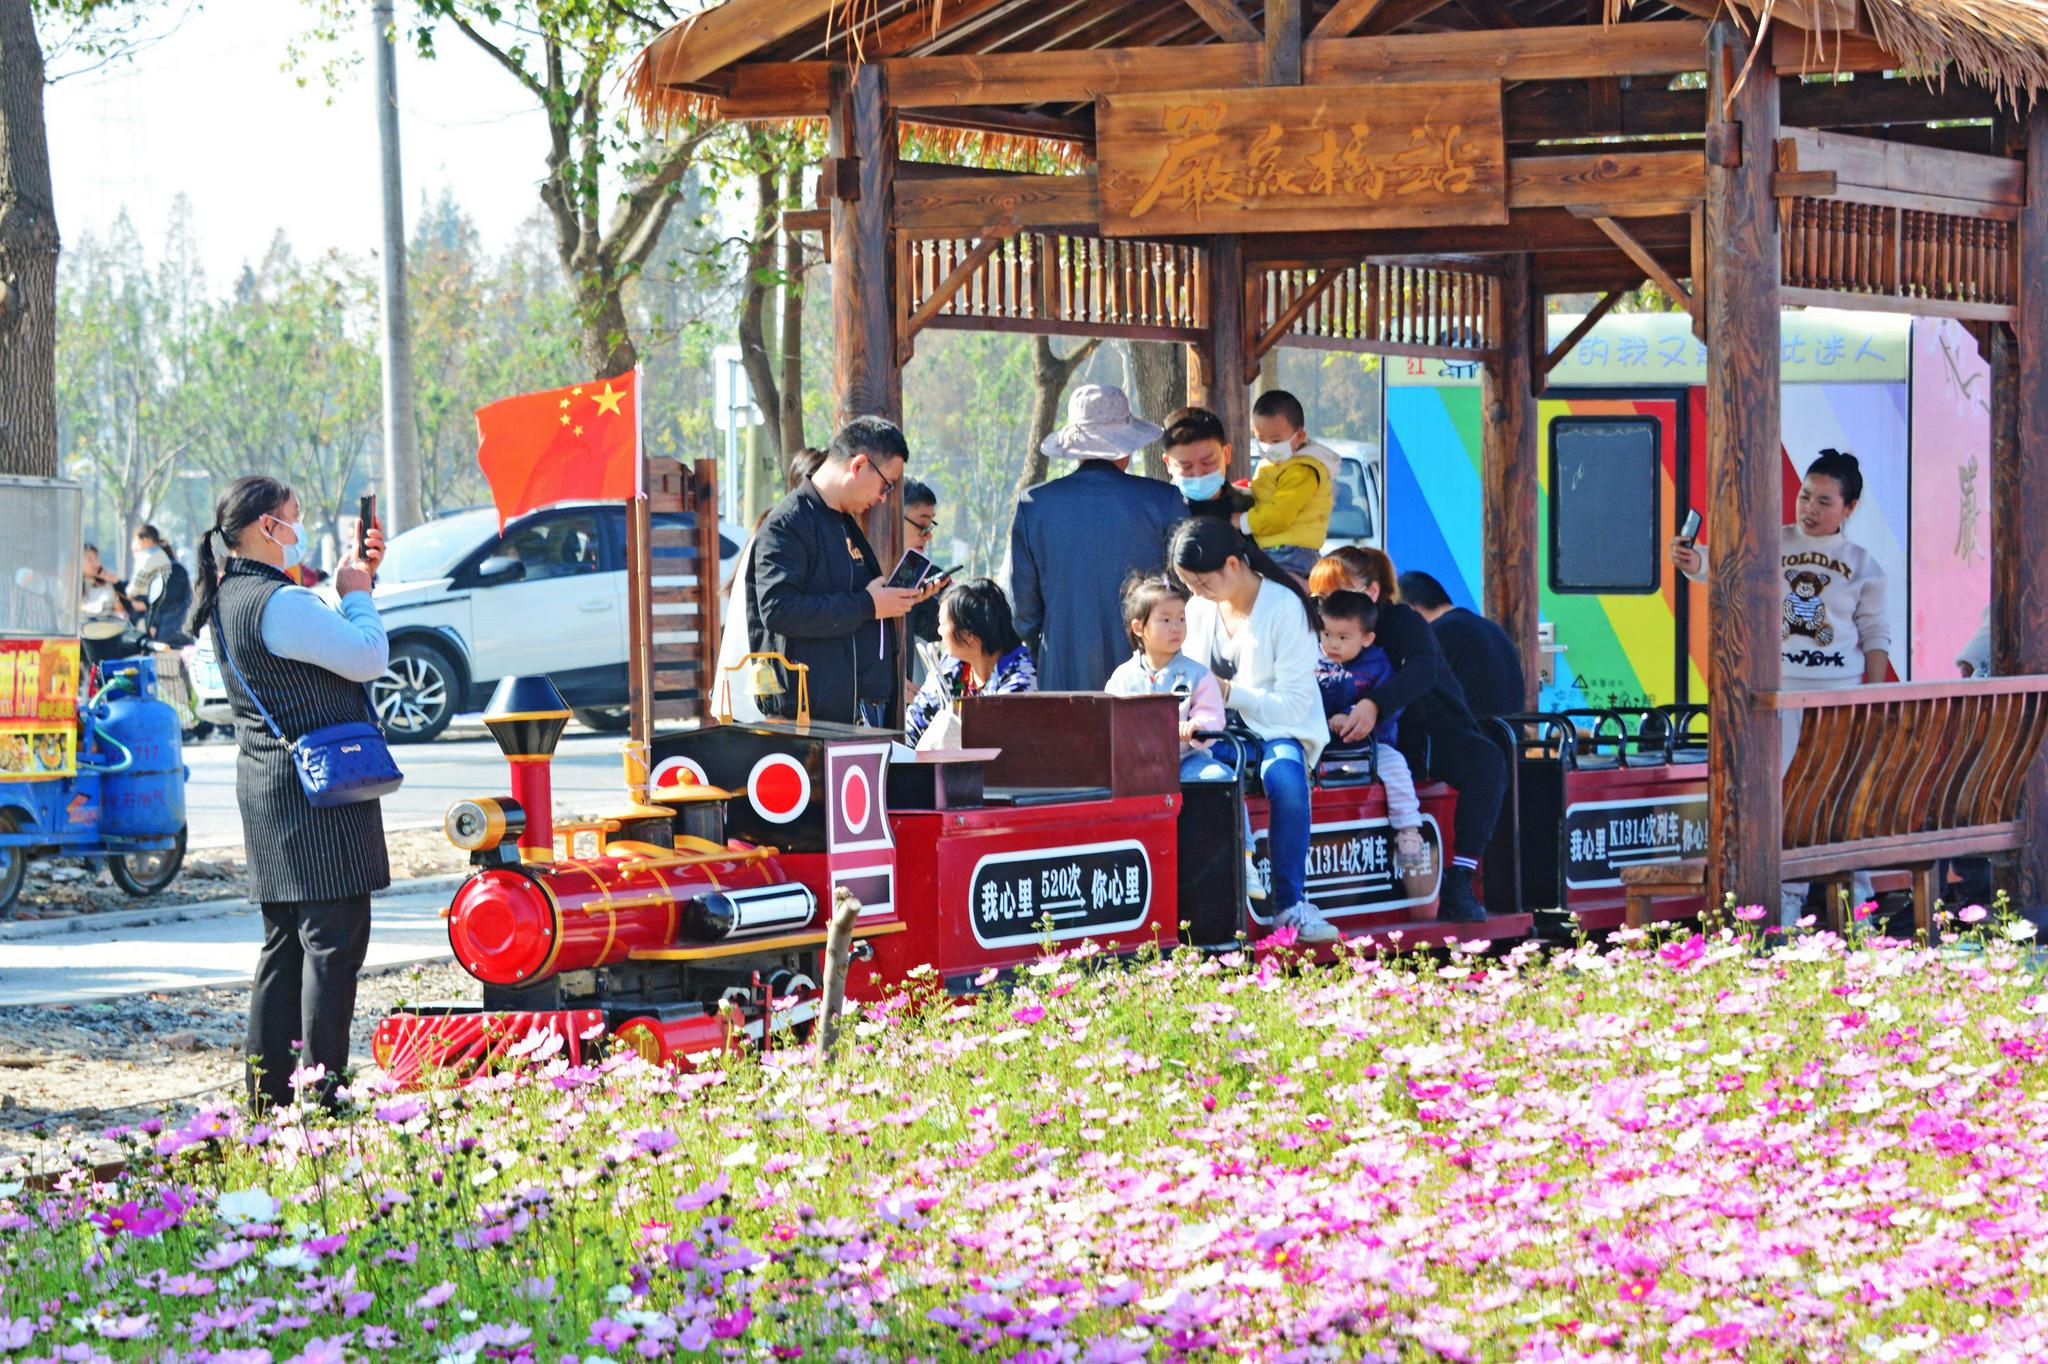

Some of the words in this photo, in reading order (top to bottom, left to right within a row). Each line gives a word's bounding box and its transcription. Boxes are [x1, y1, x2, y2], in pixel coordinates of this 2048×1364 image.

[1569, 828, 1607, 863] 我心里
[1608, 811, 1681, 847] K1314次列车
[1682, 818, 1709, 852] 你心
[981, 878, 1034, 923] 我心里
[1040, 862, 1082, 899] 520次
[1091, 865, 1141, 910] 你心里
